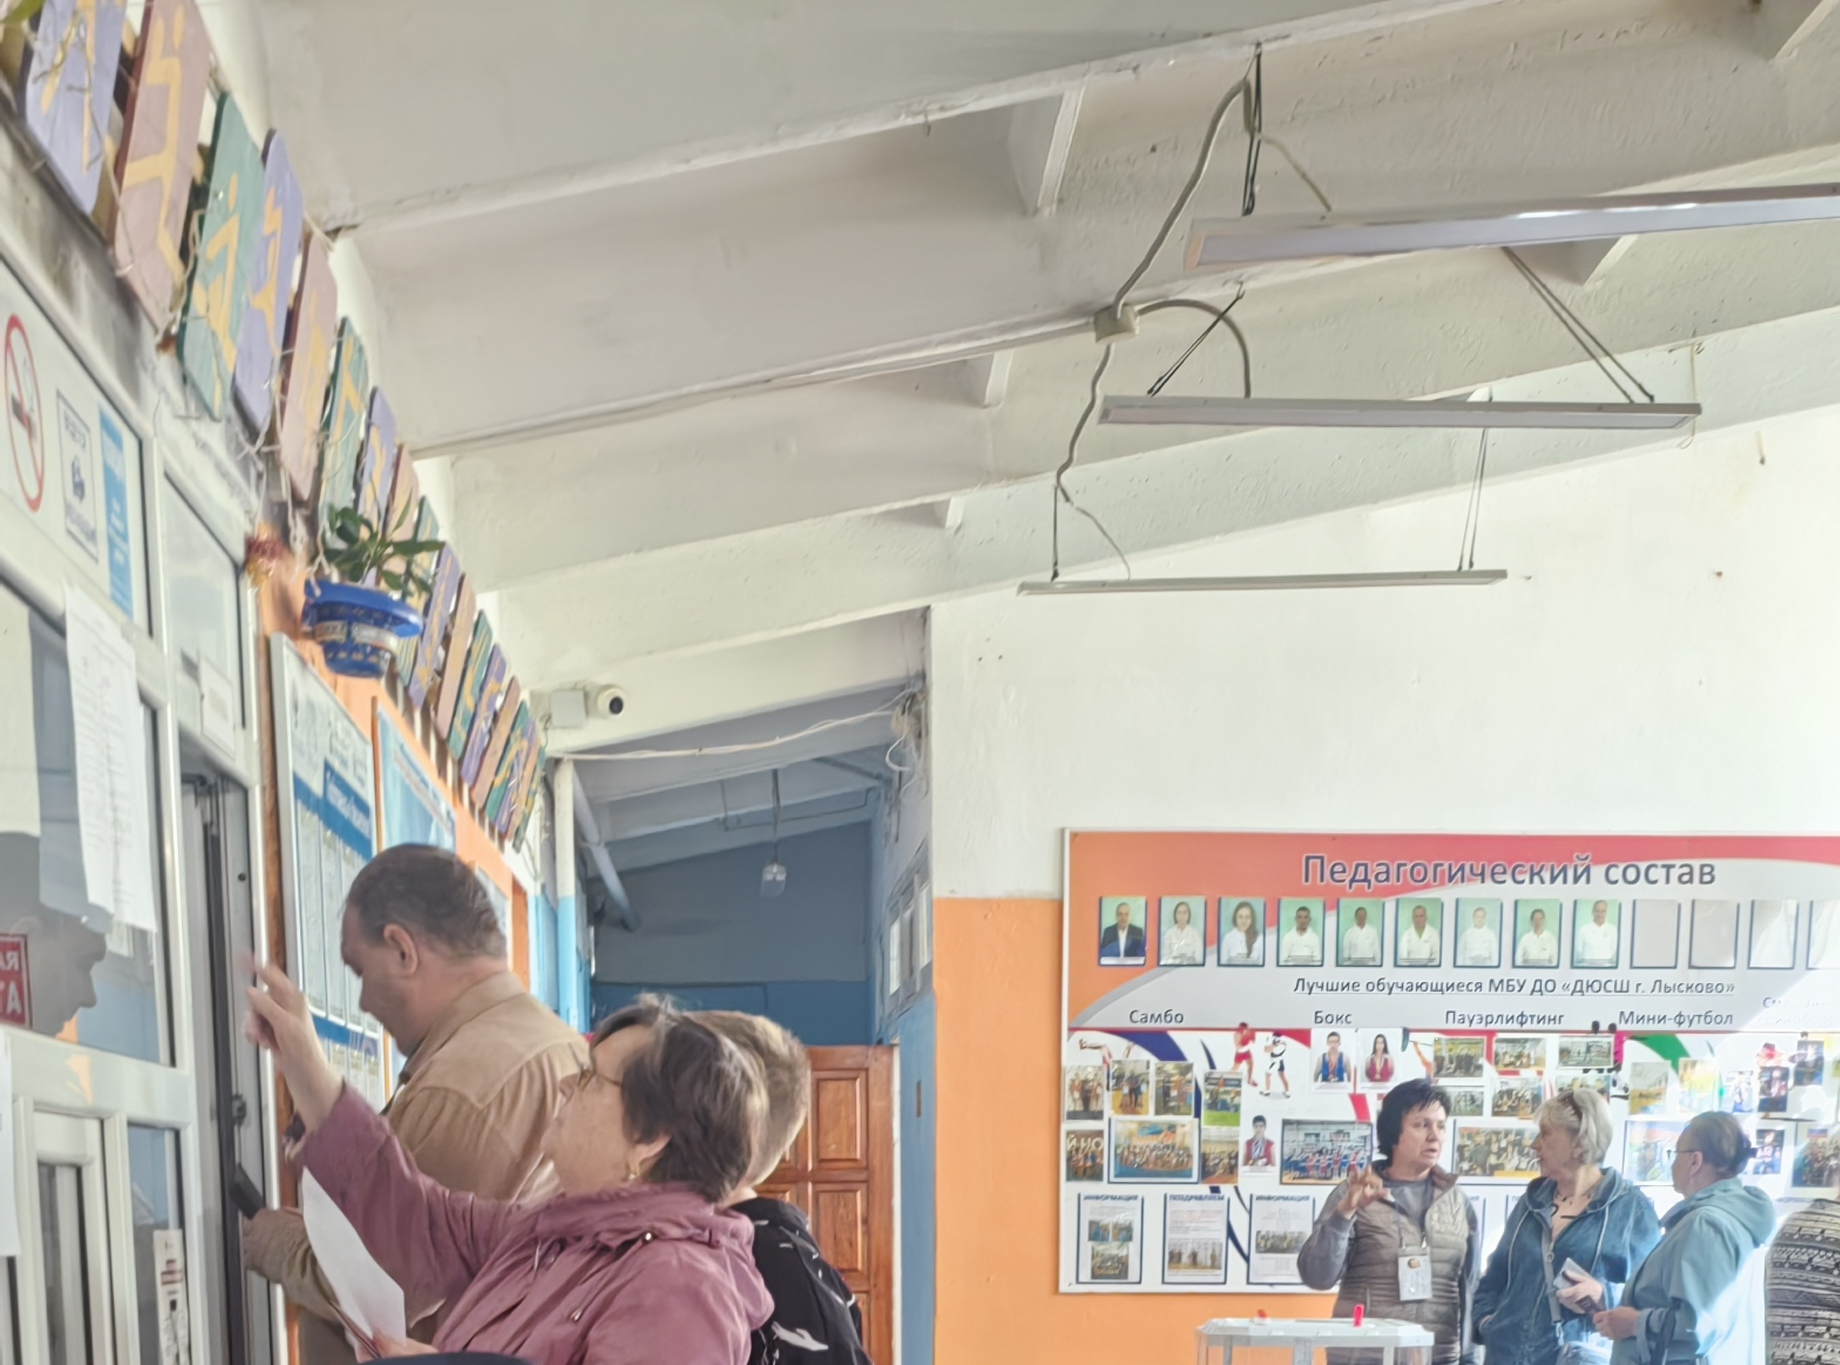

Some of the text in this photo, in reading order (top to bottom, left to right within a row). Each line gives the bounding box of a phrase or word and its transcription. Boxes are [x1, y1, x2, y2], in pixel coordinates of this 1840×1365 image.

[1303, 853, 1716, 890] Педагогический состав
[1294, 978, 1360, 995] Лучшие
[1366, 978, 1482, 995] обучающиеся
[1489, 979, 1527, 994] МБУ
[1530, 979, 1556, 995] ДО
[1562, 979, 1630, 996] «ДЮСШ
[1650, 980, 1735, 994] Лысково»
[1129, 1009, 1184, 1024] Самбо
[1314, 1010, 1353, 1025] Бокс
[1445, 1010, 1565, 1027] Пауэрлифтинг
[1619, 1010, 1734, 1028] Мини-футбол
